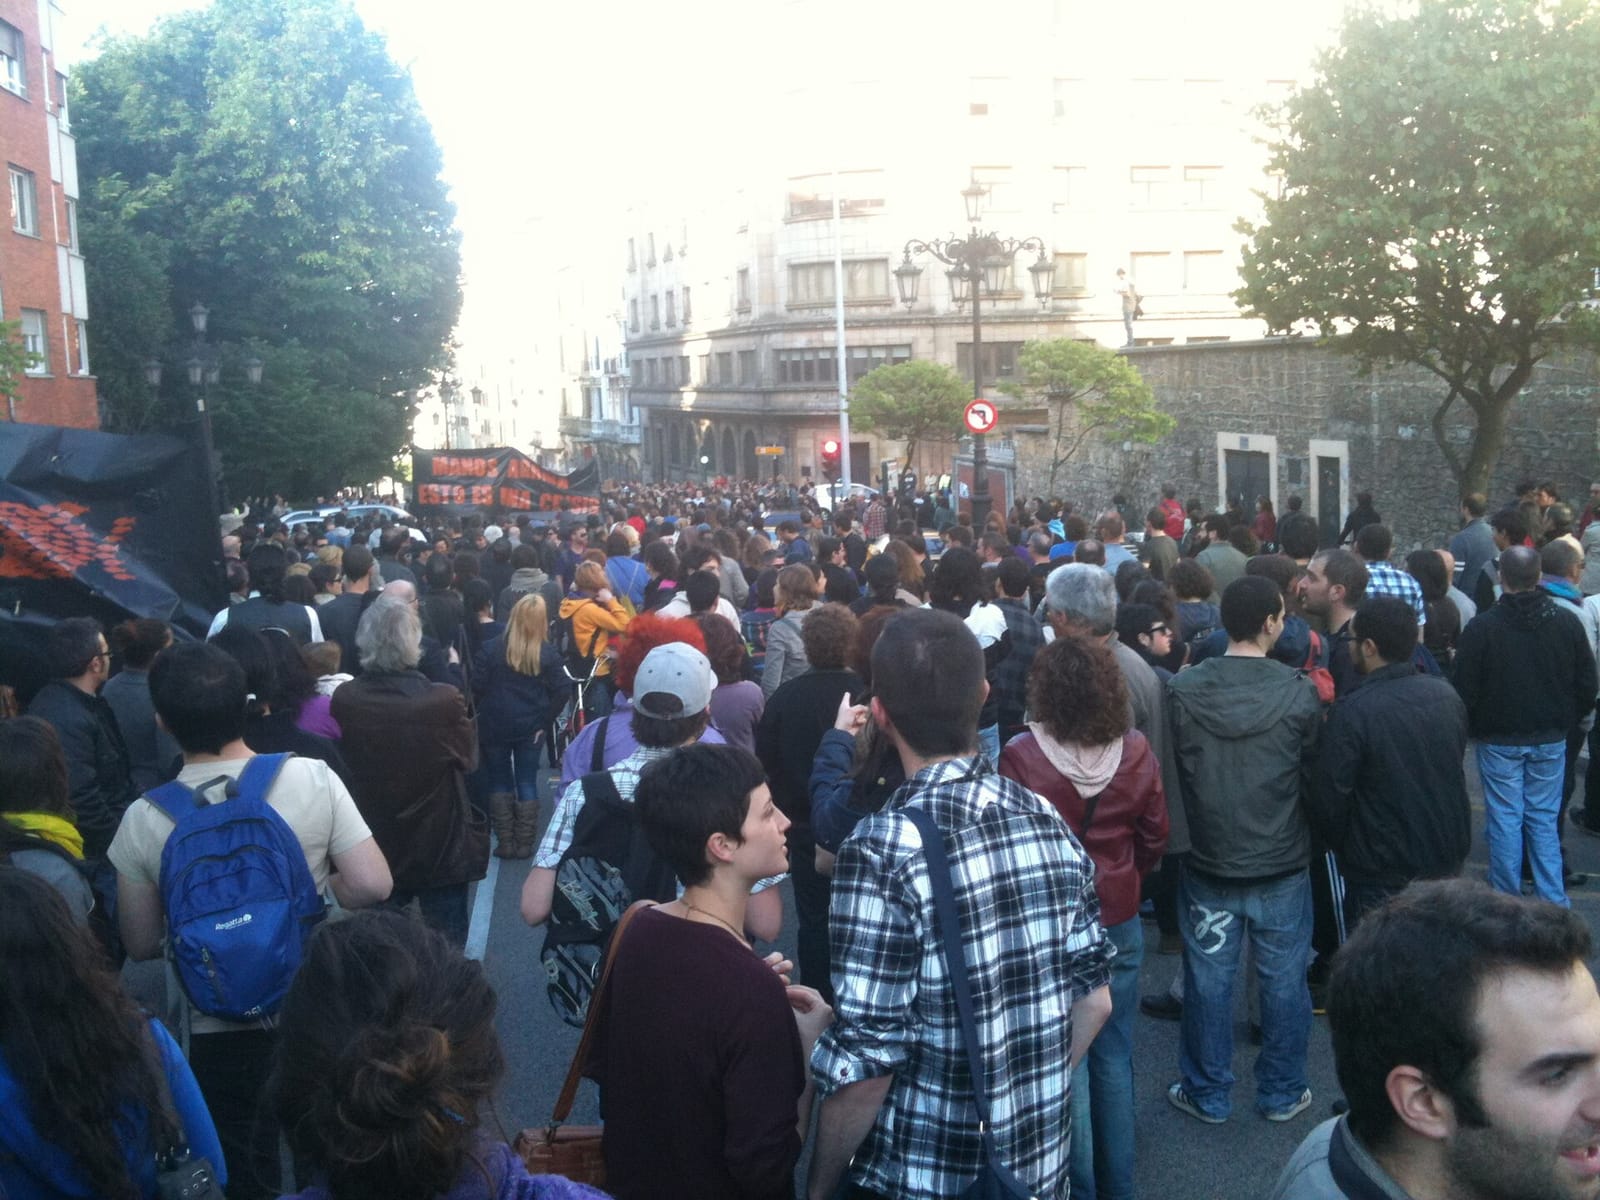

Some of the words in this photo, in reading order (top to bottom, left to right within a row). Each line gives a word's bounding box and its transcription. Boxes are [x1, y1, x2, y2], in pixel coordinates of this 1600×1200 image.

[432, 456, 498, 478] MANOS
[418, 484, 465, 505] ESTO
[471, 485, 493, 505] ES
[215, 917, 243, 930] Regatta
